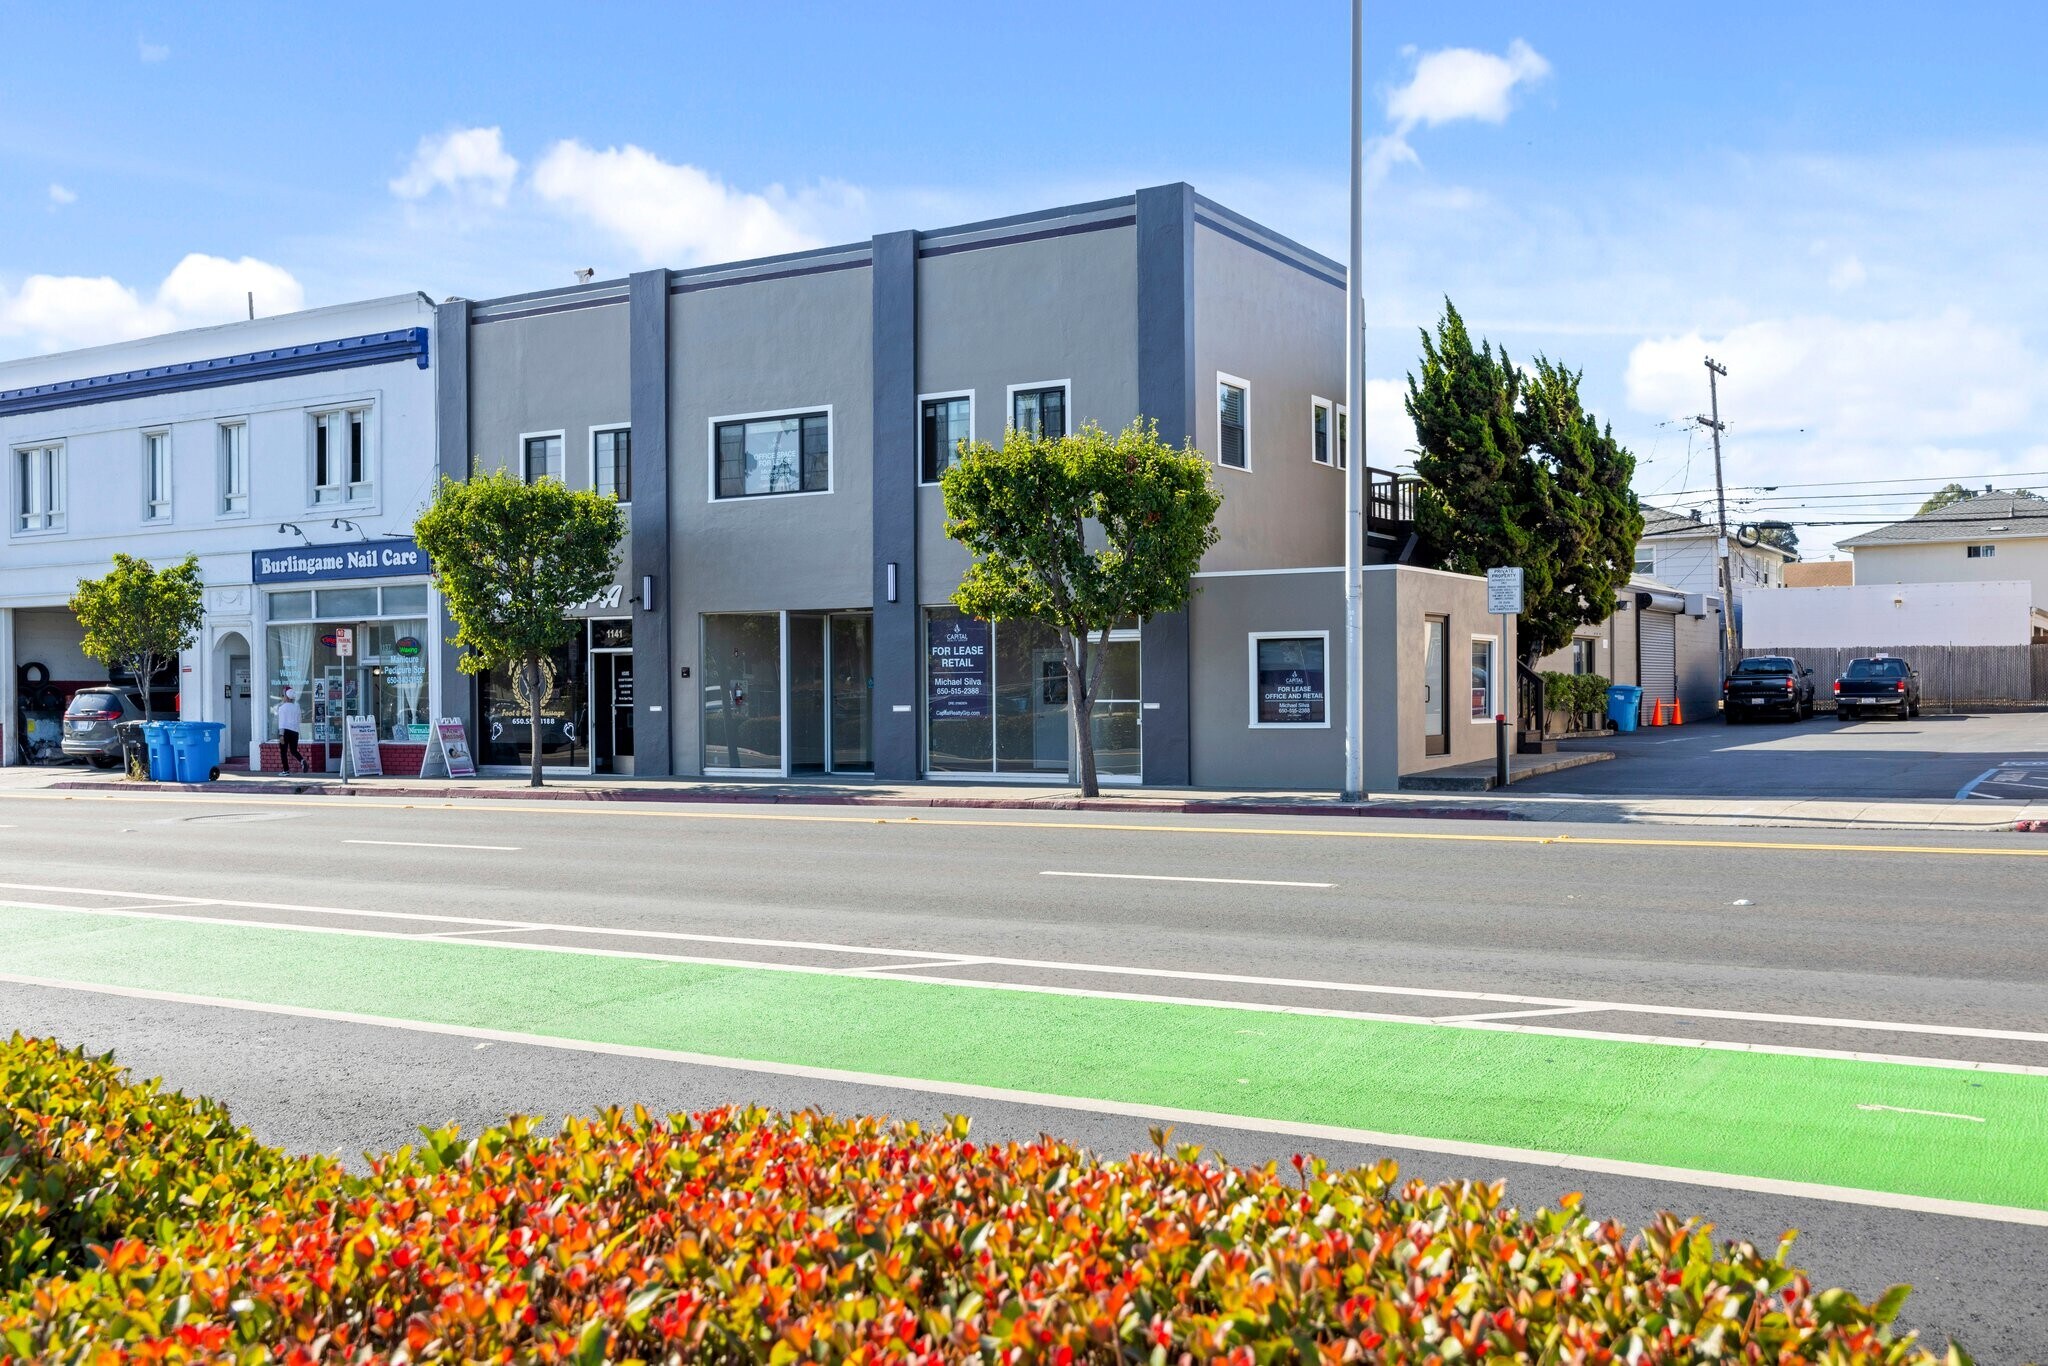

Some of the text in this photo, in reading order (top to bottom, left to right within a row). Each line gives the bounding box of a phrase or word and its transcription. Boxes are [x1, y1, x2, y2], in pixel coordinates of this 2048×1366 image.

[777, 450, 796, 458] SPACE
[261, 549, 417, 574] Burlingame Nail Care
[606, 630, 622, 638] 1141
[932, 646, 984, 656] FOR LEASE
[942, 658, 974, 668] RETAIL
[384, 666, 426, 676] Pedicure Spa
[964, 678, 982, 686] Silva
[540, 709, 565, 718] Massage
